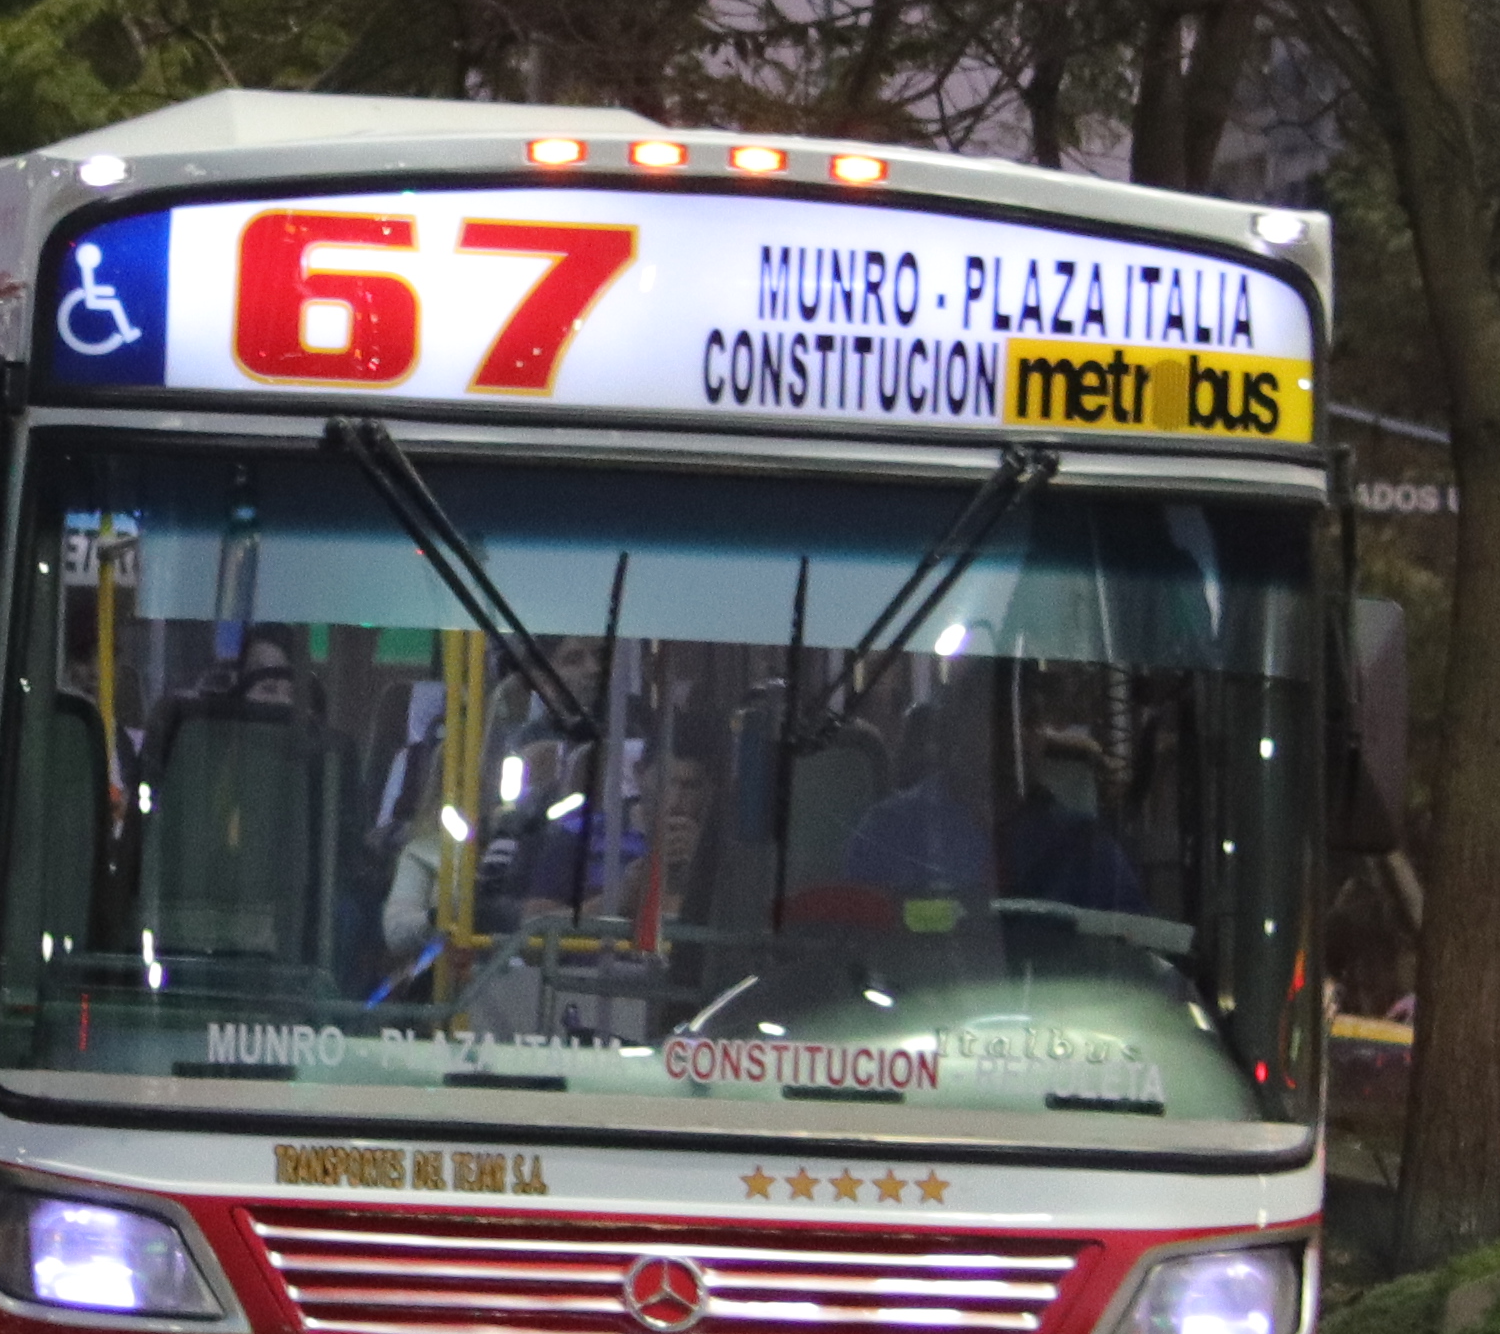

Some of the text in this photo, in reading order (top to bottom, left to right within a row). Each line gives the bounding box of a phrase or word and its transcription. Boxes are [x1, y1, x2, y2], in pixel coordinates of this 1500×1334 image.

[231, 208, 640, 396] 67
[757, 244, 921, 327] MUNRO
[962, 255, 1106, 337] PLAZA
[1123, 264, 1254, 349] ITALIA
[702, 328, 999, 417] CONSTITUCION
[206, 1022, 346, 1065] MUNRO
[380, 1027, 495, 1071] PLAZA
[664, 1035, 939, 1089] CONSTITUCION
